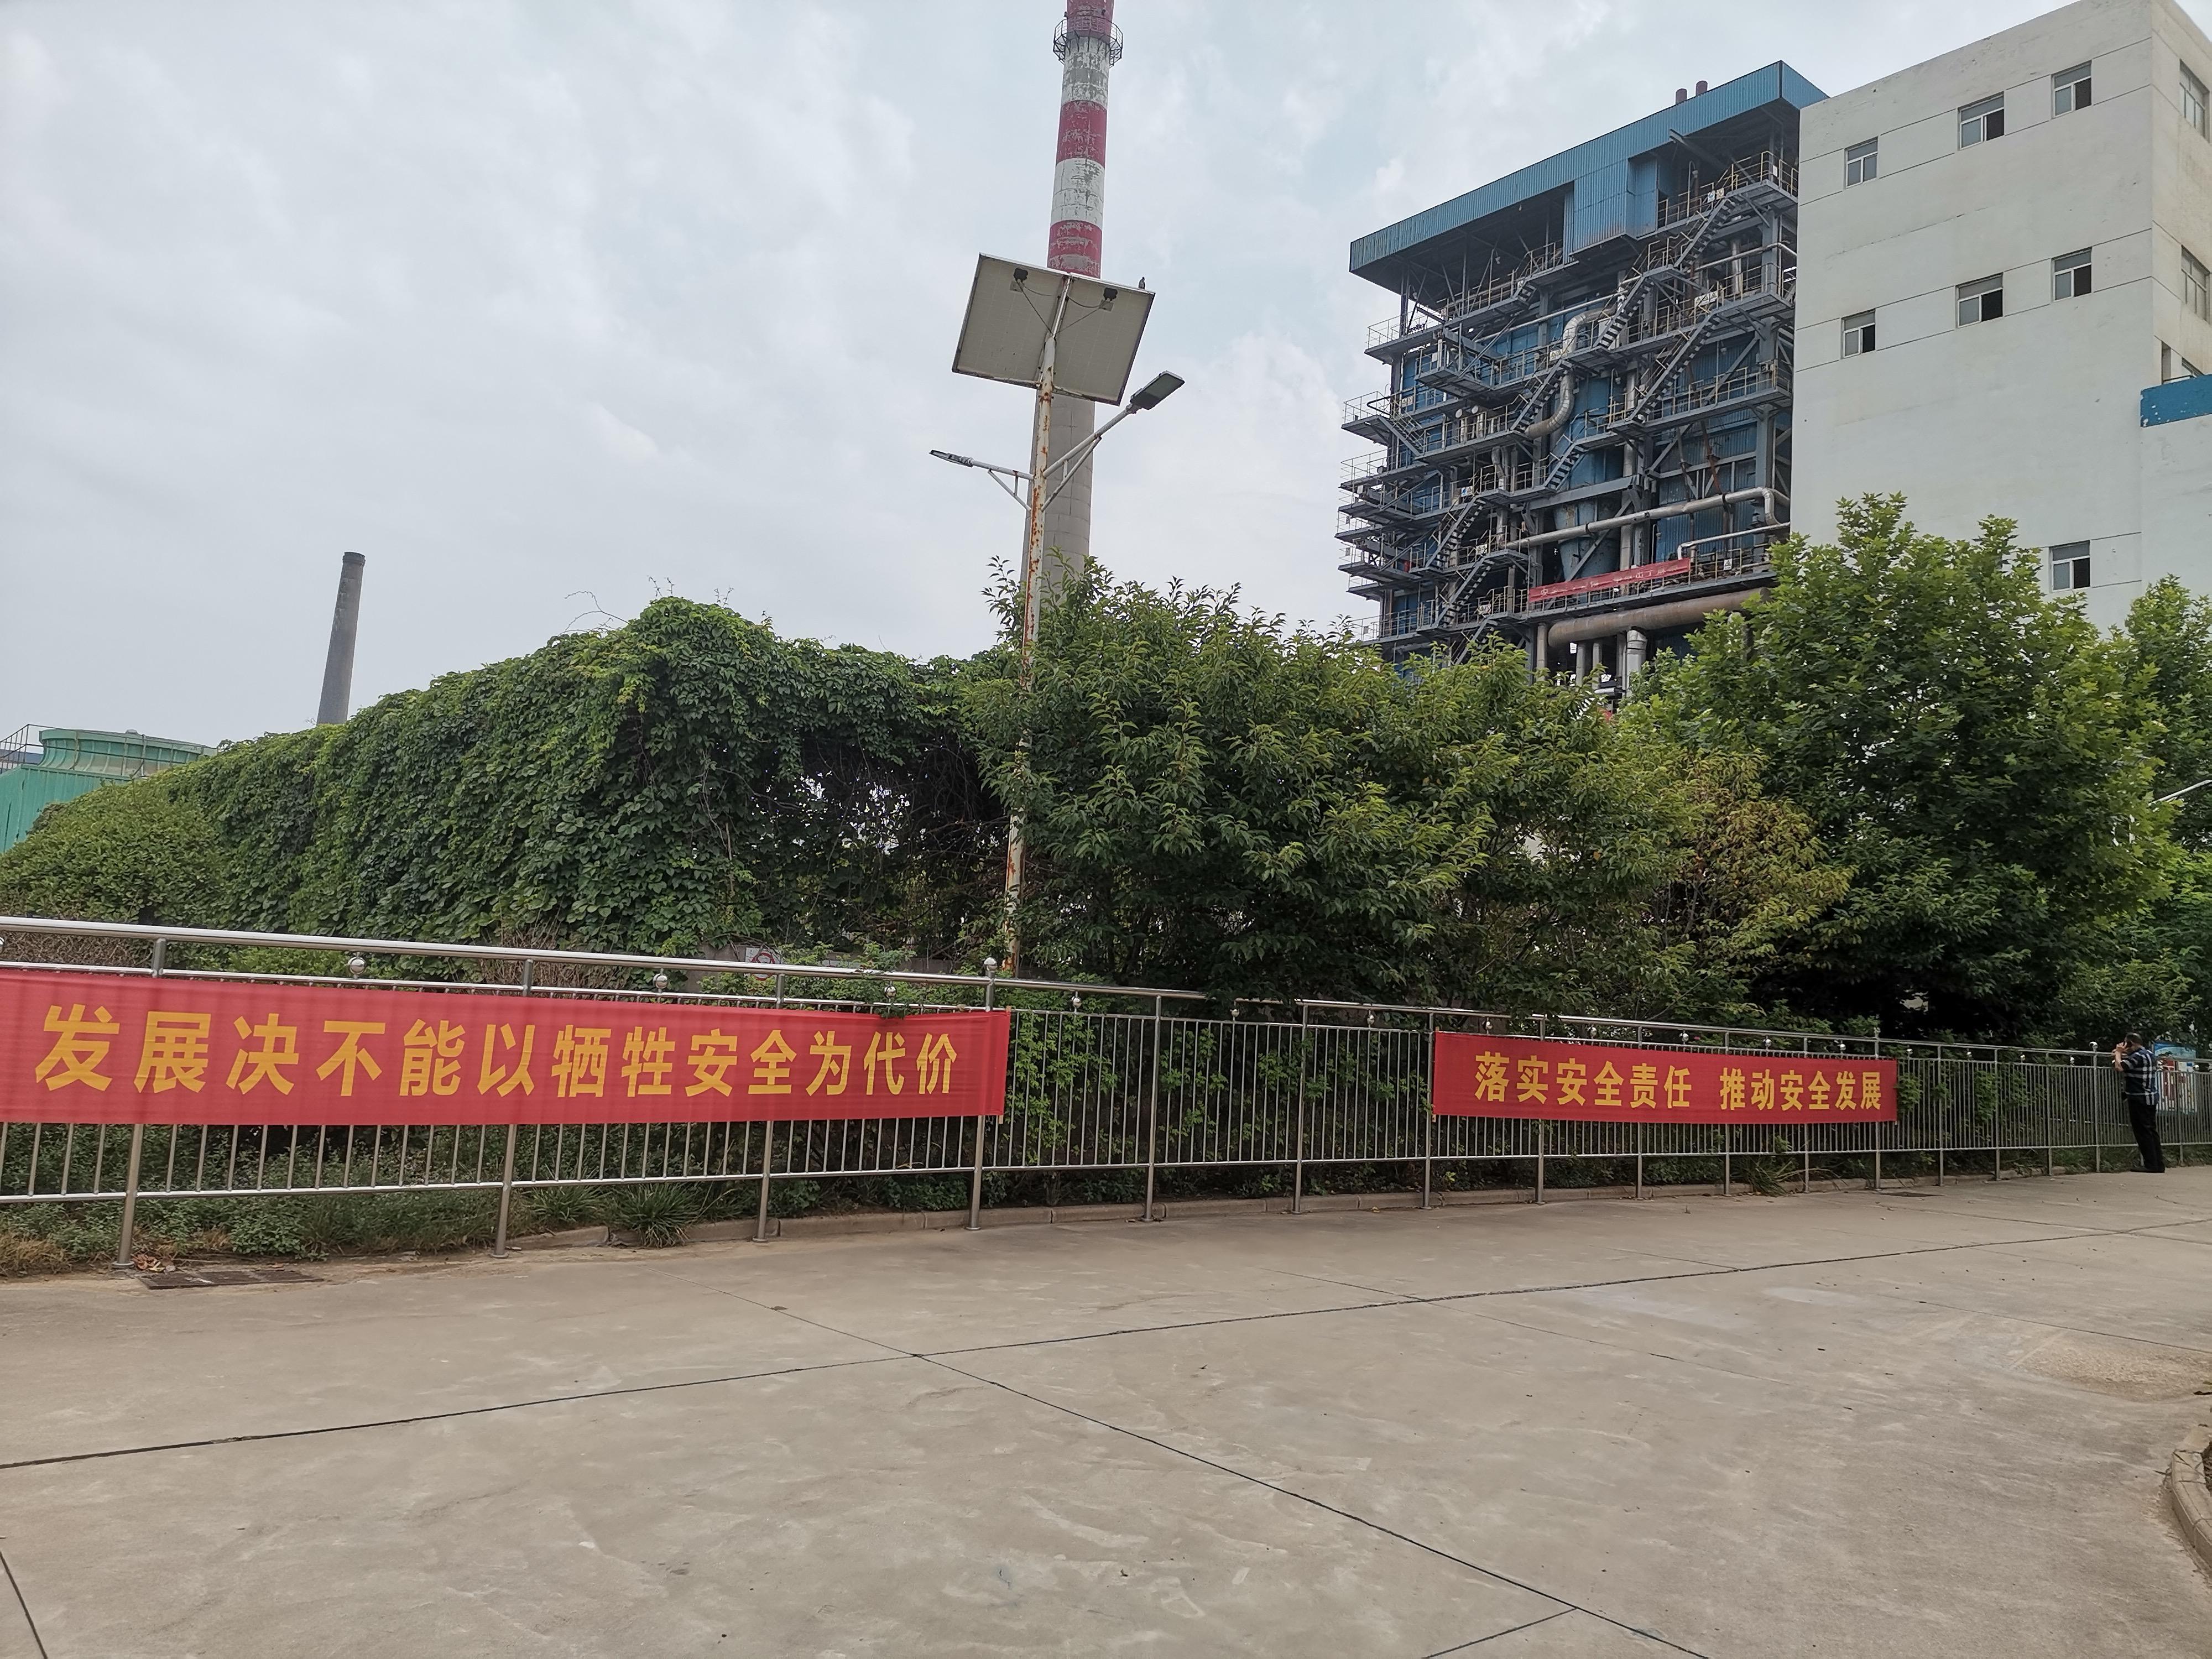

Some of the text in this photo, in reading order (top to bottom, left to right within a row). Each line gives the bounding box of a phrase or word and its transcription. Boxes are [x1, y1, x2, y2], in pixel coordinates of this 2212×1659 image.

[35, 1004, 957, 1098] 发展决不能以牺牲安全为代价
[1474, 1051, 1881, 1110] 落实安全责任 推动安全发展
